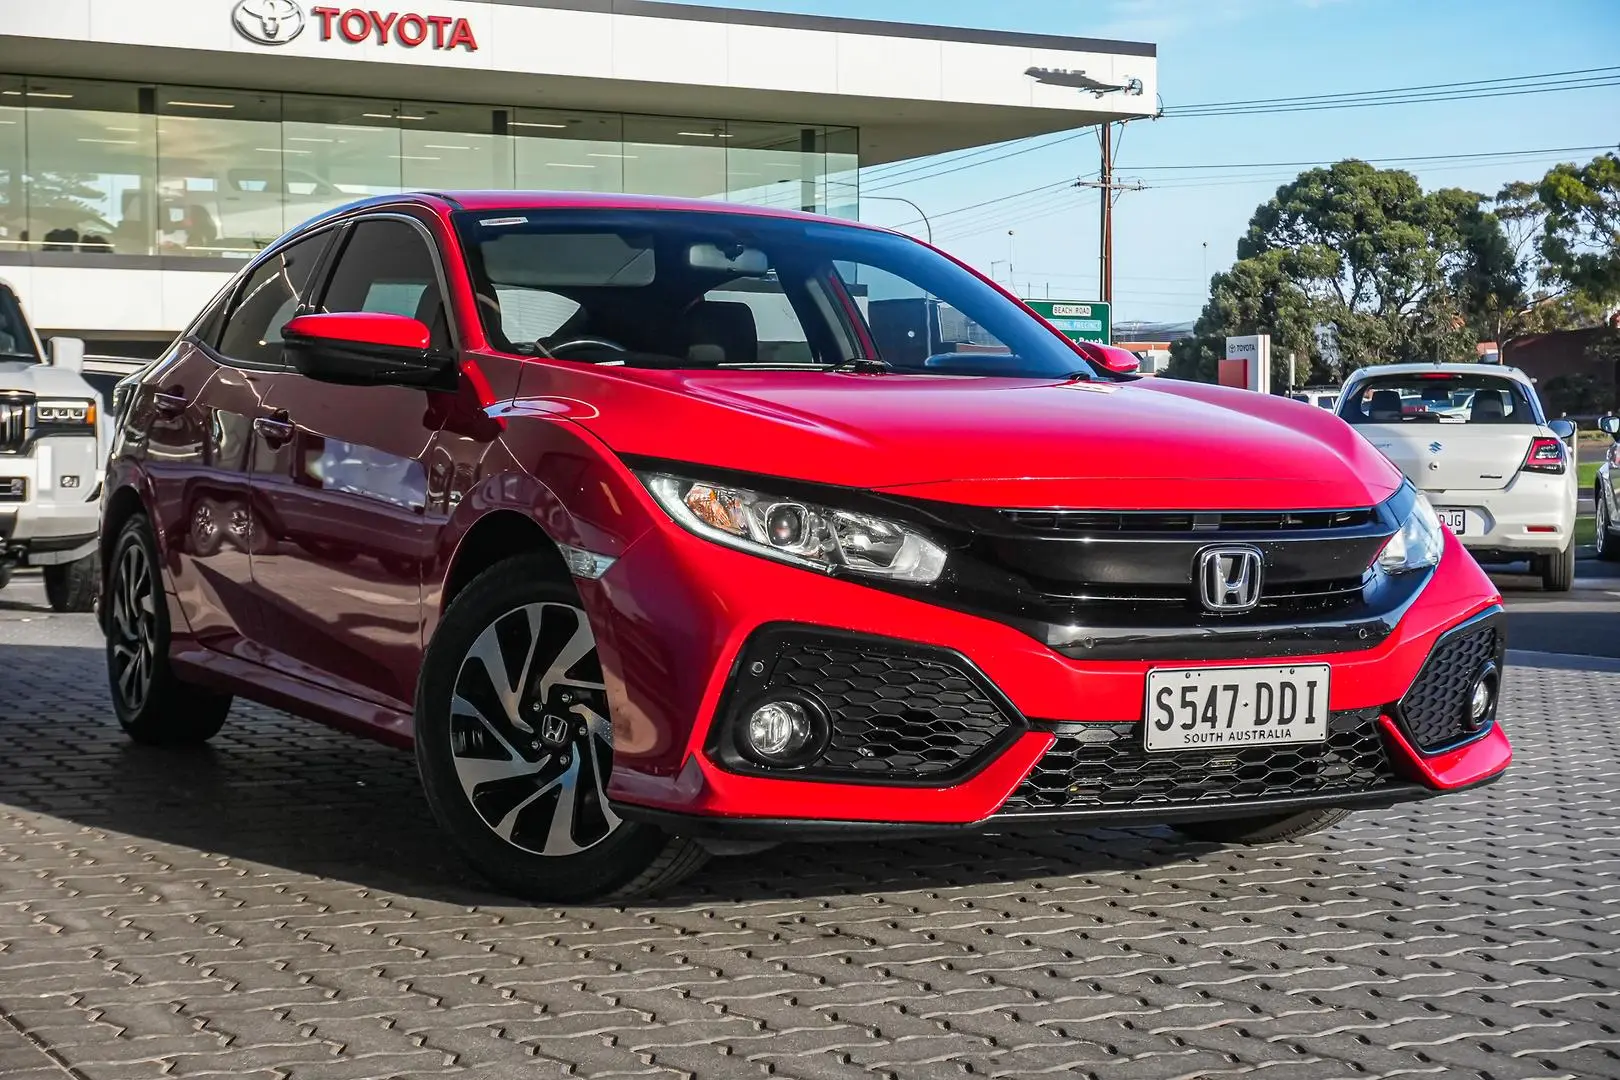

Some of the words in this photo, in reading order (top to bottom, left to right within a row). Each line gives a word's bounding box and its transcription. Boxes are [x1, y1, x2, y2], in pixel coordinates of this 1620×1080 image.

[312, 6, 479, 51] TOYOTA
[1053, 306, 1073, 314] BEACH
[1075, 306, 1091, 315] ROAD
[1236, 343, 1256, 352] TOYOTA
[1184, 730, 1223, 744] SOUTH
[1228, 727, 1292, 742] AUSTRALIA
